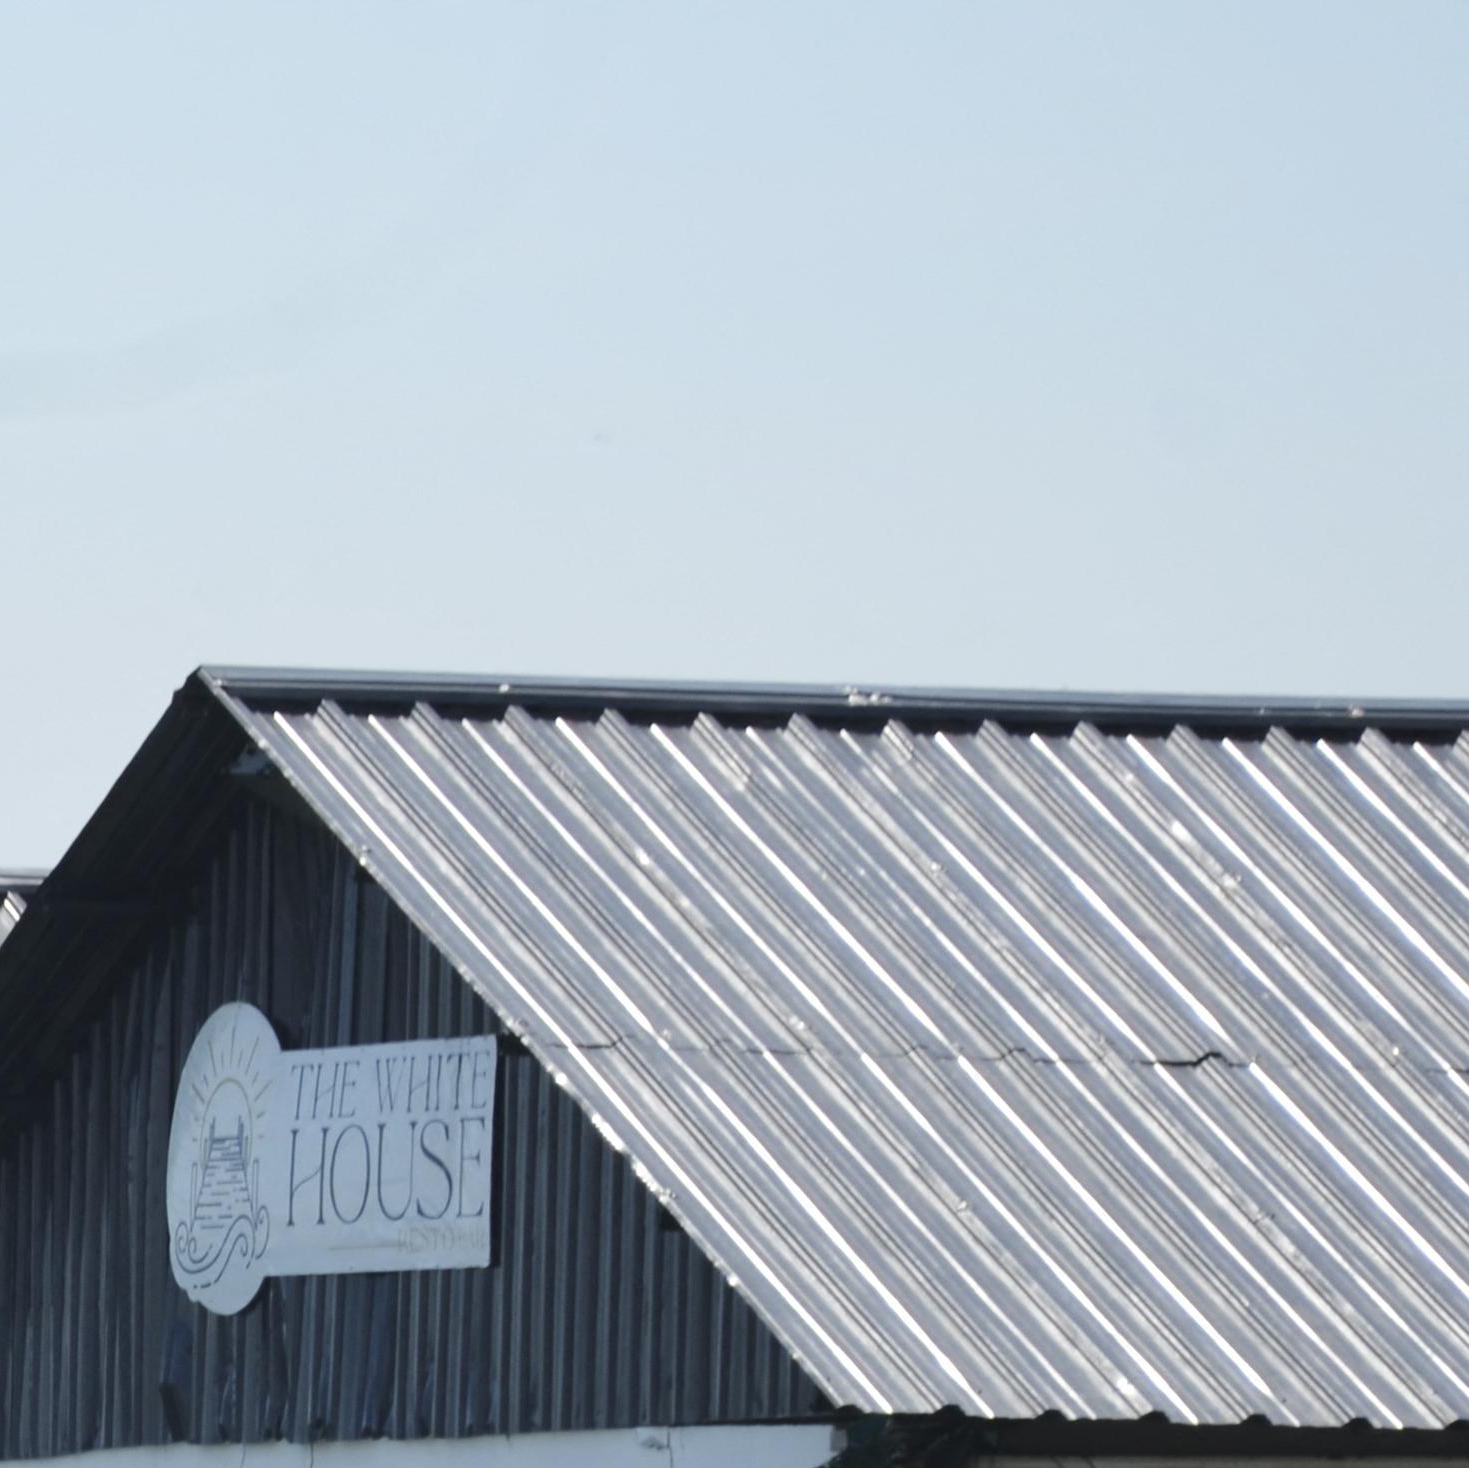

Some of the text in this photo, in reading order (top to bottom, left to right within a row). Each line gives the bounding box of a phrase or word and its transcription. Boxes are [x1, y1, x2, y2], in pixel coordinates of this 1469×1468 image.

[291, 1049, 491, 1121] THE WHITE
[286, 1117, 486, 1227] HOUSE
